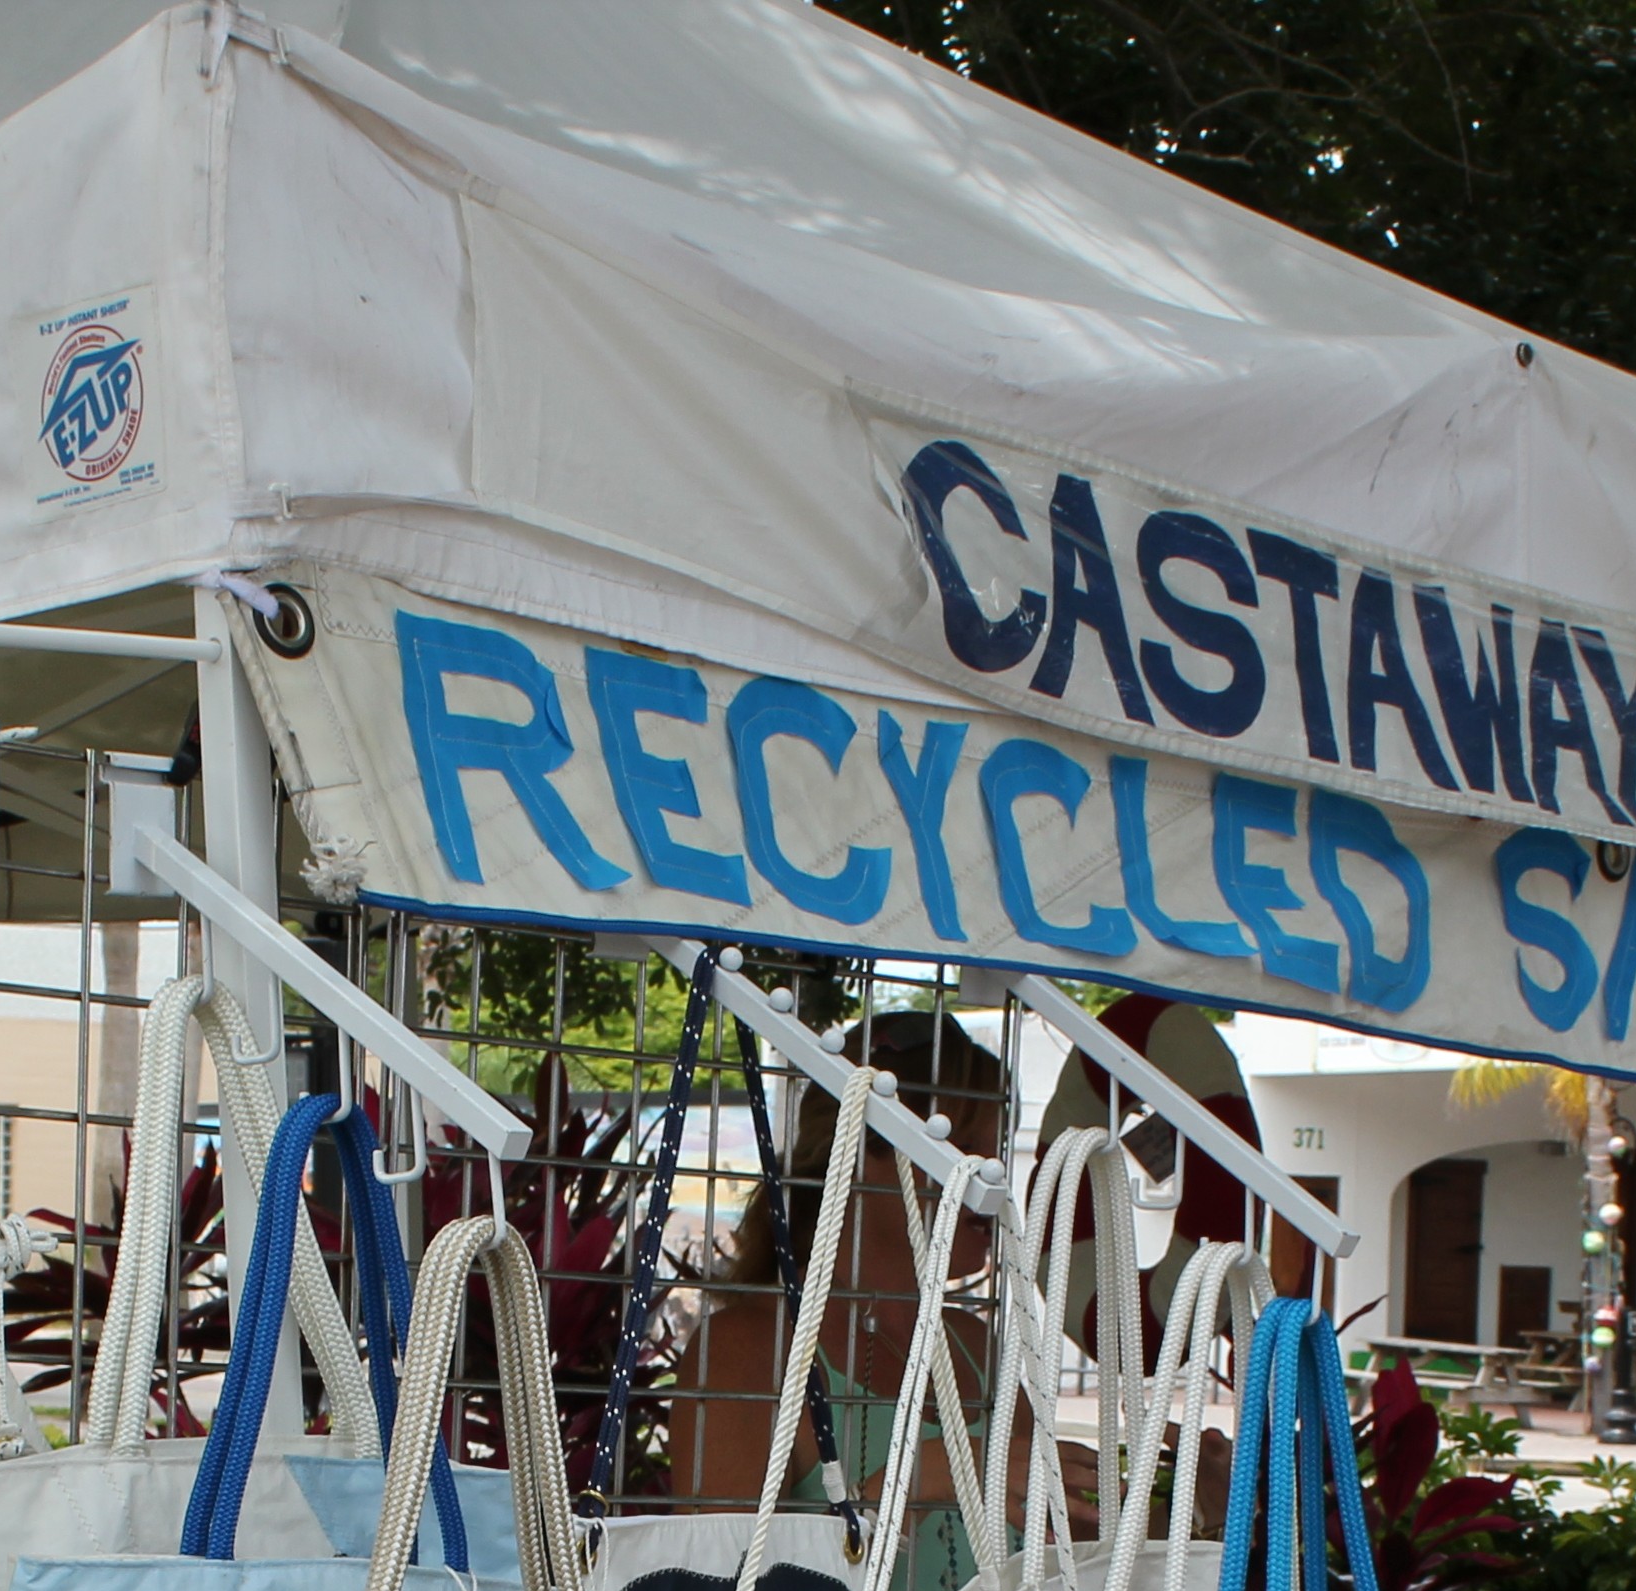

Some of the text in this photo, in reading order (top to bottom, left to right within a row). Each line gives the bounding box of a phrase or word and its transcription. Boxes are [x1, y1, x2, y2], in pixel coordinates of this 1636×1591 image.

[85, 447, 123, 476] ORIGINAL
[121, 408, 139, 447] SHADE
[395, 608, 1431, 1015] RECYCLED
[1292, 1127, 1325, 1150] 371
